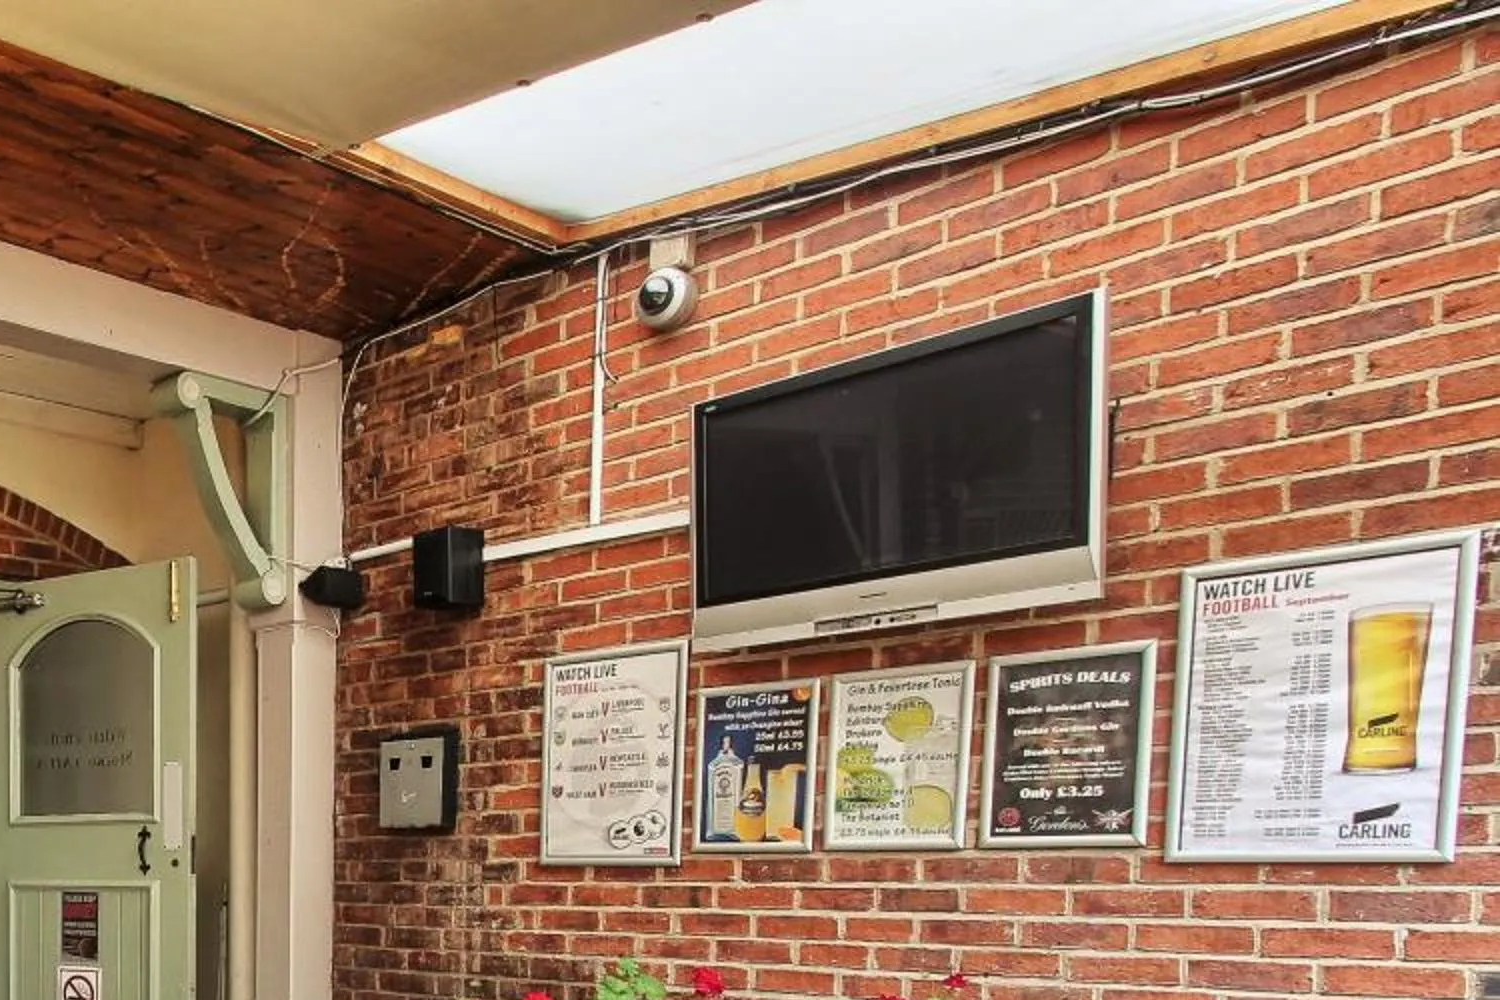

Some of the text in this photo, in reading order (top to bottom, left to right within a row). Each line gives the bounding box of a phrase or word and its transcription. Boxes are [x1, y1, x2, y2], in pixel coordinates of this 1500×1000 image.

[1203, 571, 1316, 600] WATCH LIVE
[1203, 595, 1278, 616] FOOTBALL
[556, 663, 618, 681] WATCH LIVE
[555, 682, 598, 697] FOOTBALL
[1009, 671, 1131, 693] SPIRITS DEALS
[1357, 725, 1409, 739] CARLING
[1019, 785, 1105, 801] Only £3.25
[1338, 823, 1412, 839] CARLING
